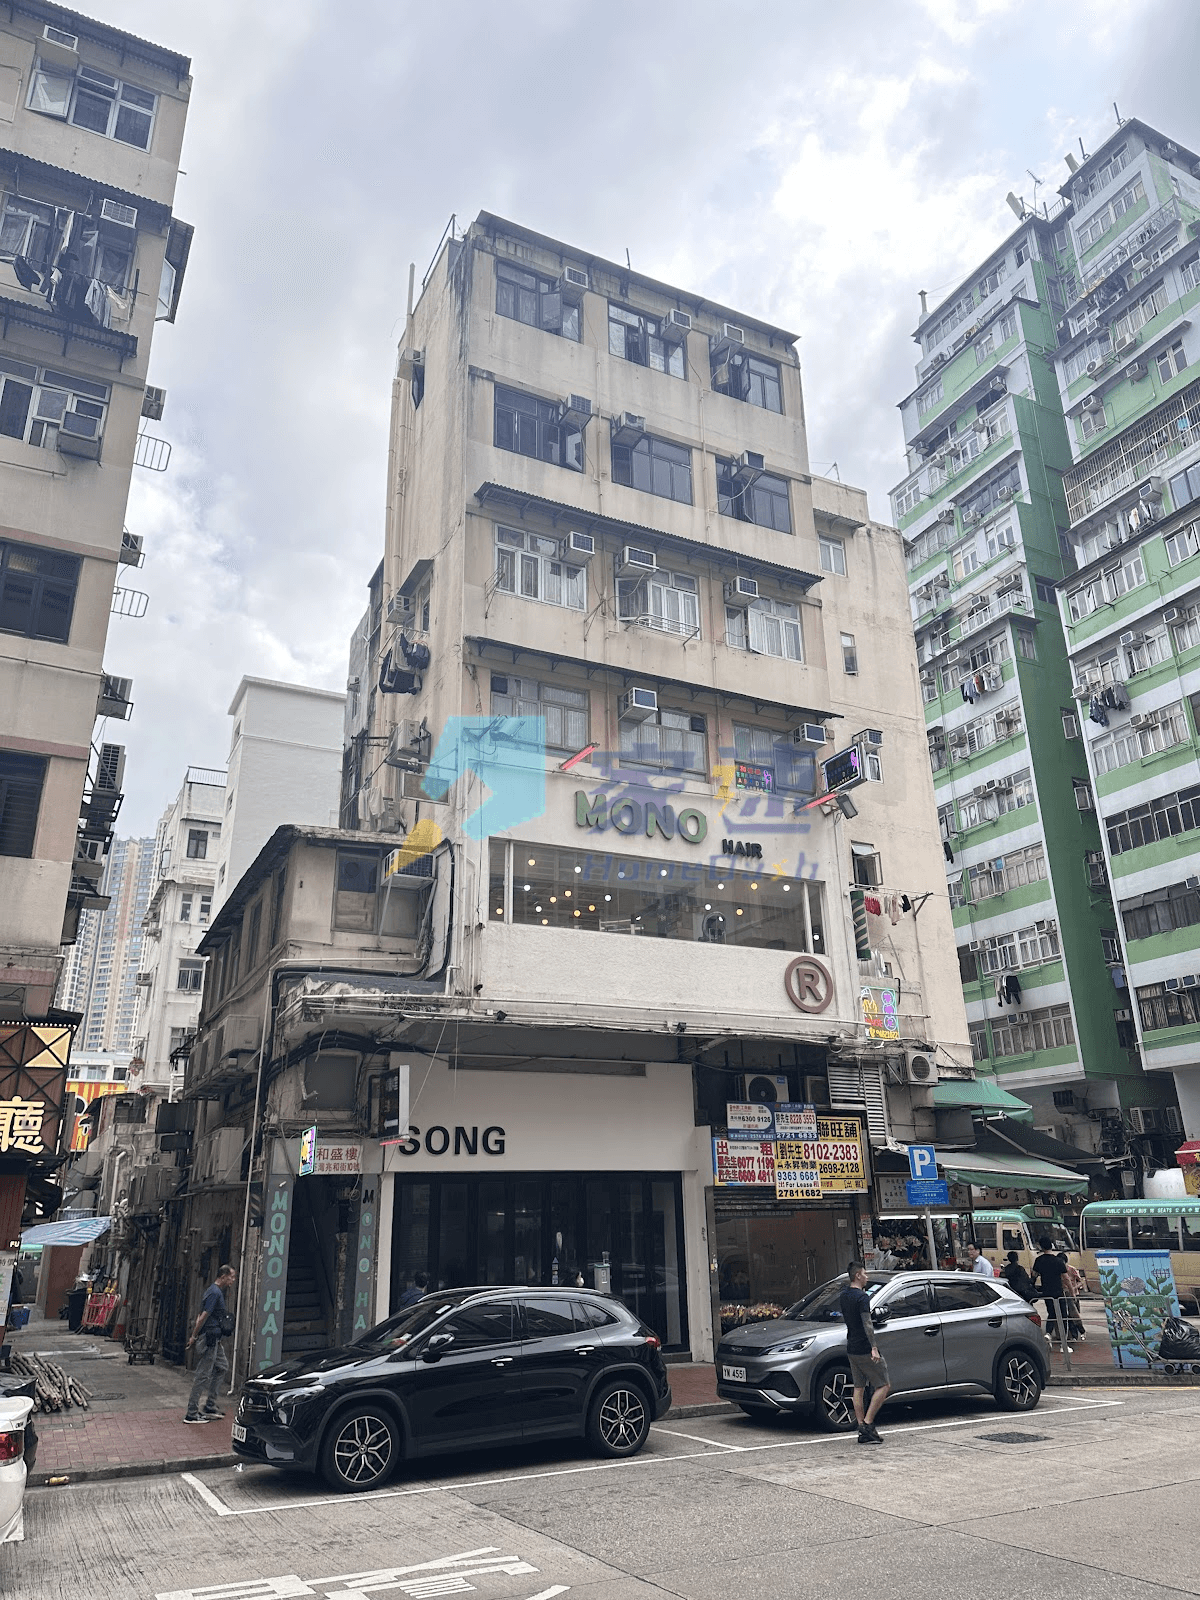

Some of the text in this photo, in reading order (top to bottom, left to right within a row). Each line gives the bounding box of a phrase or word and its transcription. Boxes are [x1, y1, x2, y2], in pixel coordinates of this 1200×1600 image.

[575, 790, 708, 844] MONO
[722, 838, 763, 860] HAIR
[398, 1125, 506, 1155] SONG
[716, 1140, 729, 1155] 出
[316, 1147, 359, 1161] 和盛樓
[912, 1149, 931, 1177] P
[777, 1171, 819, 1181] 9363 6681
[778, 1189, 822, 1198] 27811682
[266, 1190, 289, 1279] MONO
[359, 1189, 375, 1273] MONO
